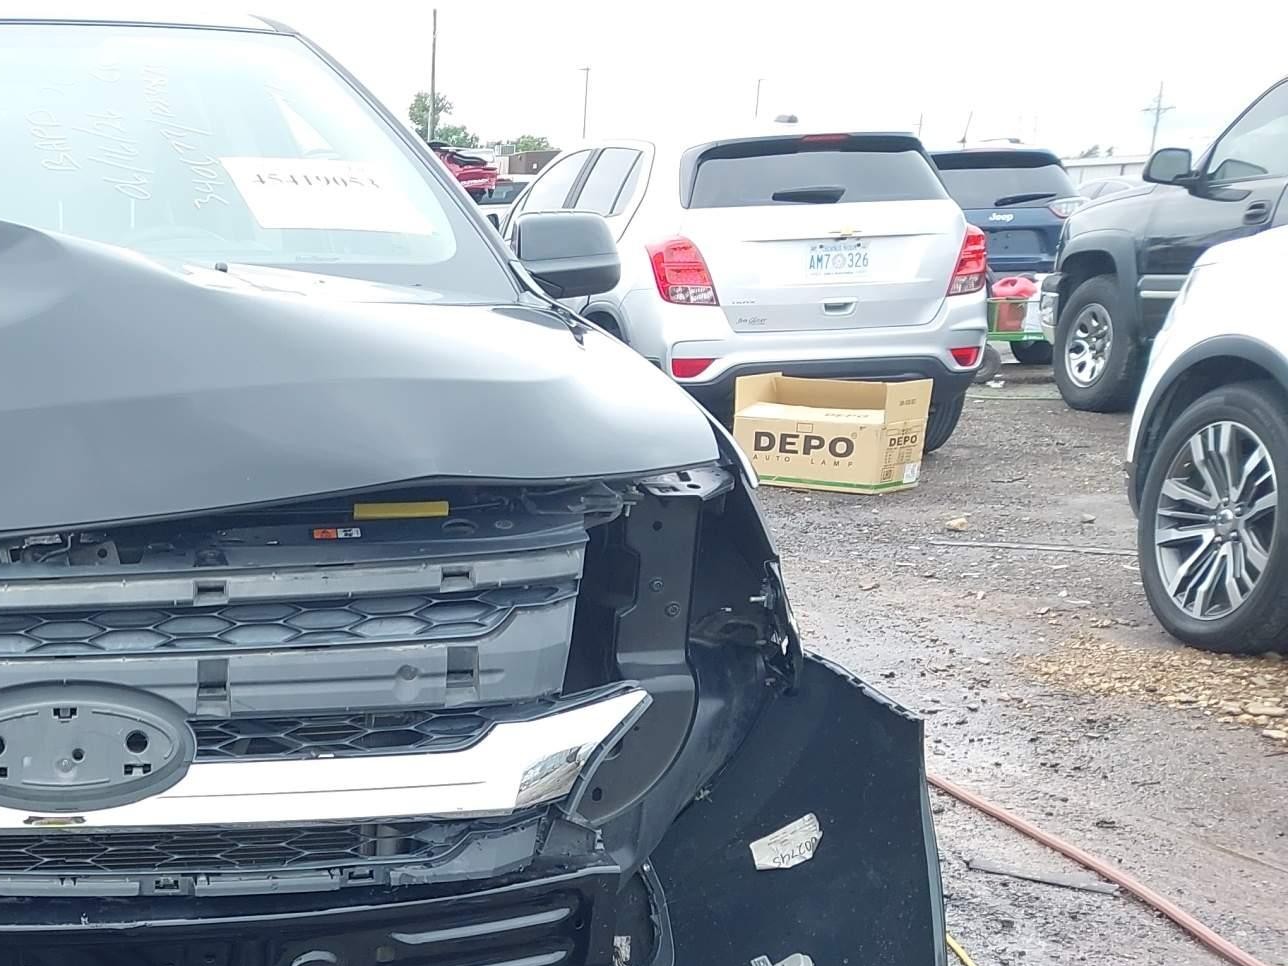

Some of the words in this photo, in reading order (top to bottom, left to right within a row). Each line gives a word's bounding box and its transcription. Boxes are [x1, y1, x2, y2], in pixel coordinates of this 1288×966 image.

[988, 212, 1014, 223] Jeep
[847, 252, 869, 268] 326
[753, 431, 855, 458] DEPO
[888, 434, 918, 447] DEPO
[753, 454, 791, 463] AUTO
[810, 458, 854, 467] LAMP
